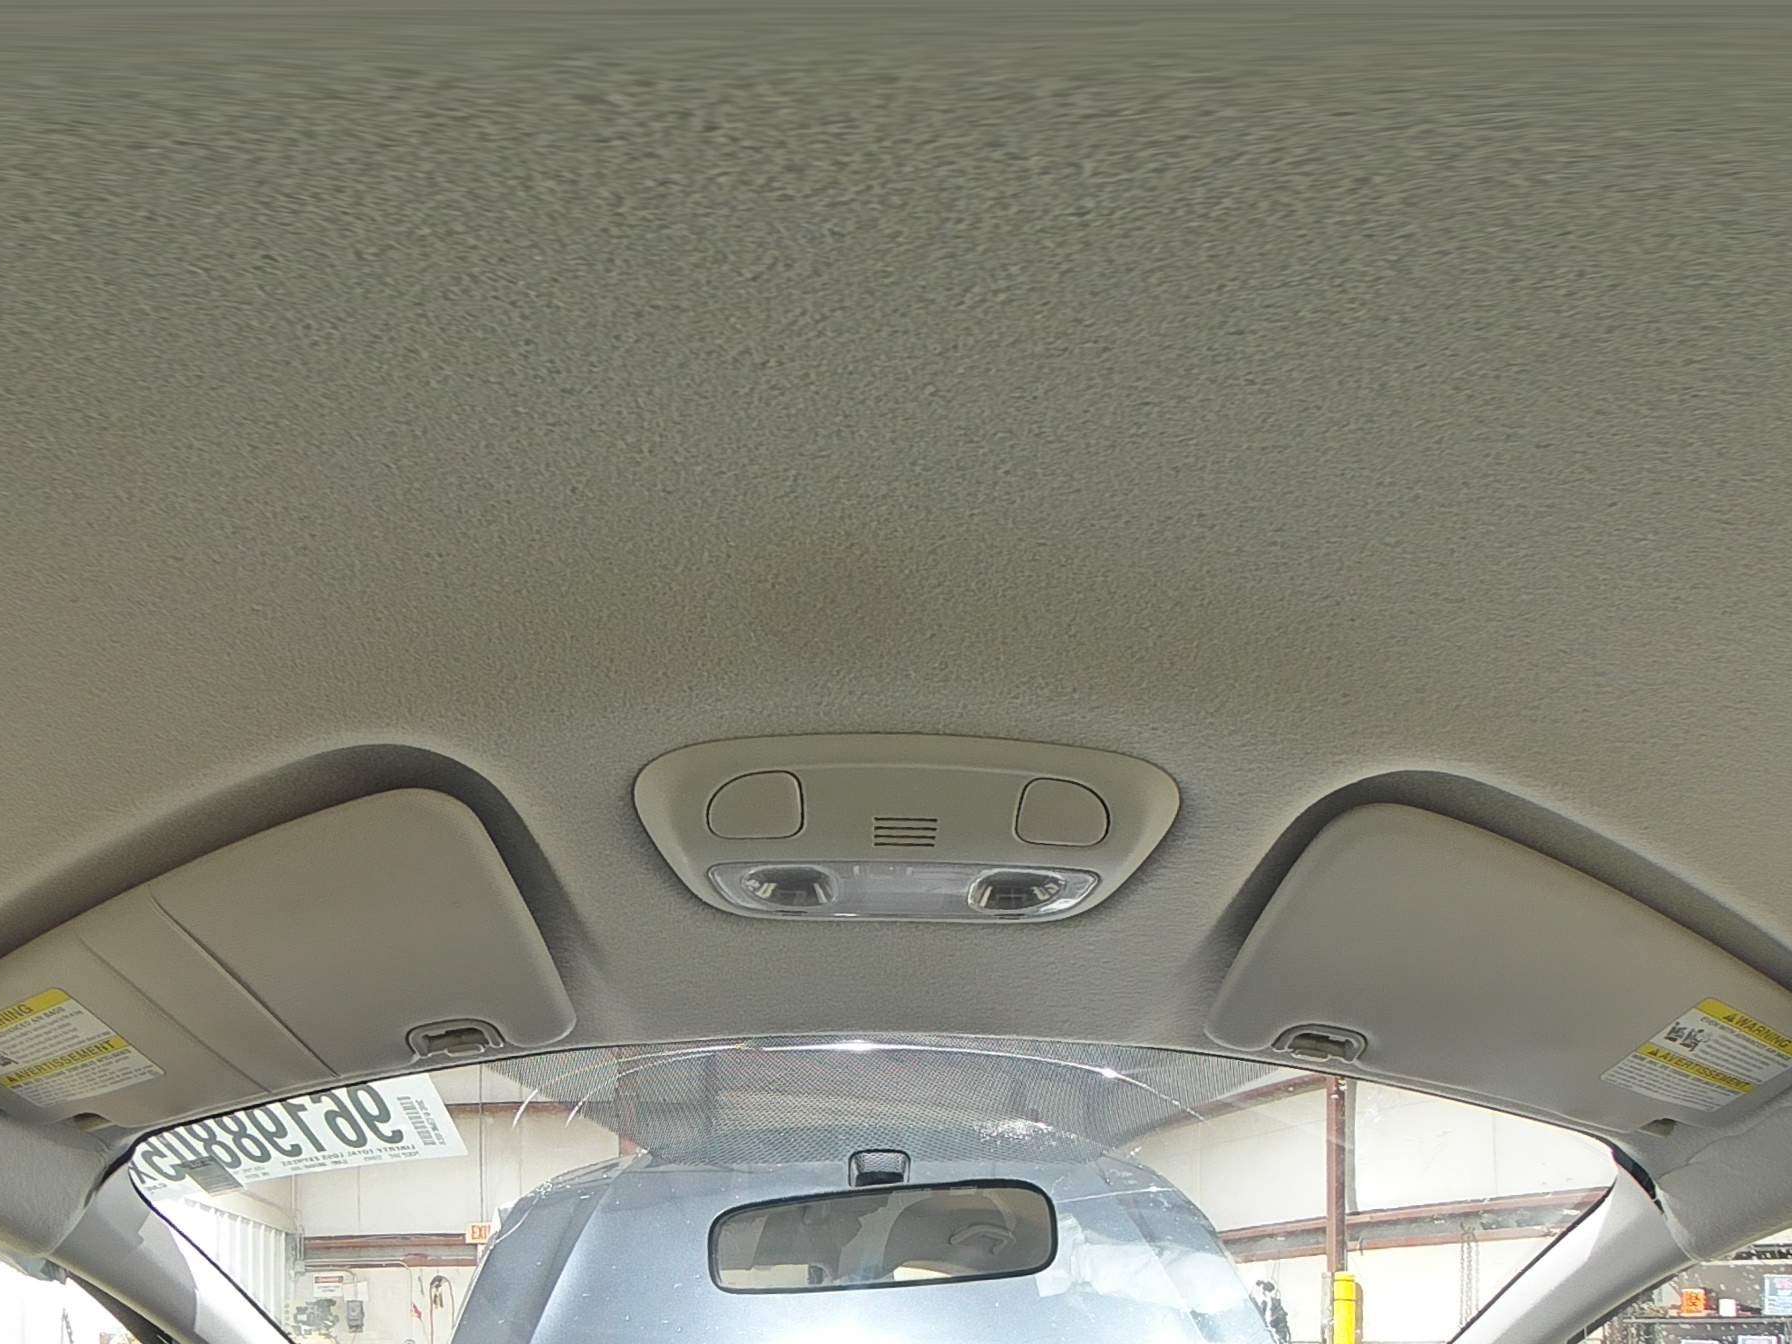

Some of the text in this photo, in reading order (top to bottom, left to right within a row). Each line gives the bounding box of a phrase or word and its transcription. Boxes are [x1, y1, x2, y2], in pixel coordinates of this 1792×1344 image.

[1735, 1015, 1792, 1048] WARNING
[15, 1039, 116, 1080] AVERTISSEMENT
[1661, 1052, 1751, 1089] AVERTISSEMENT
